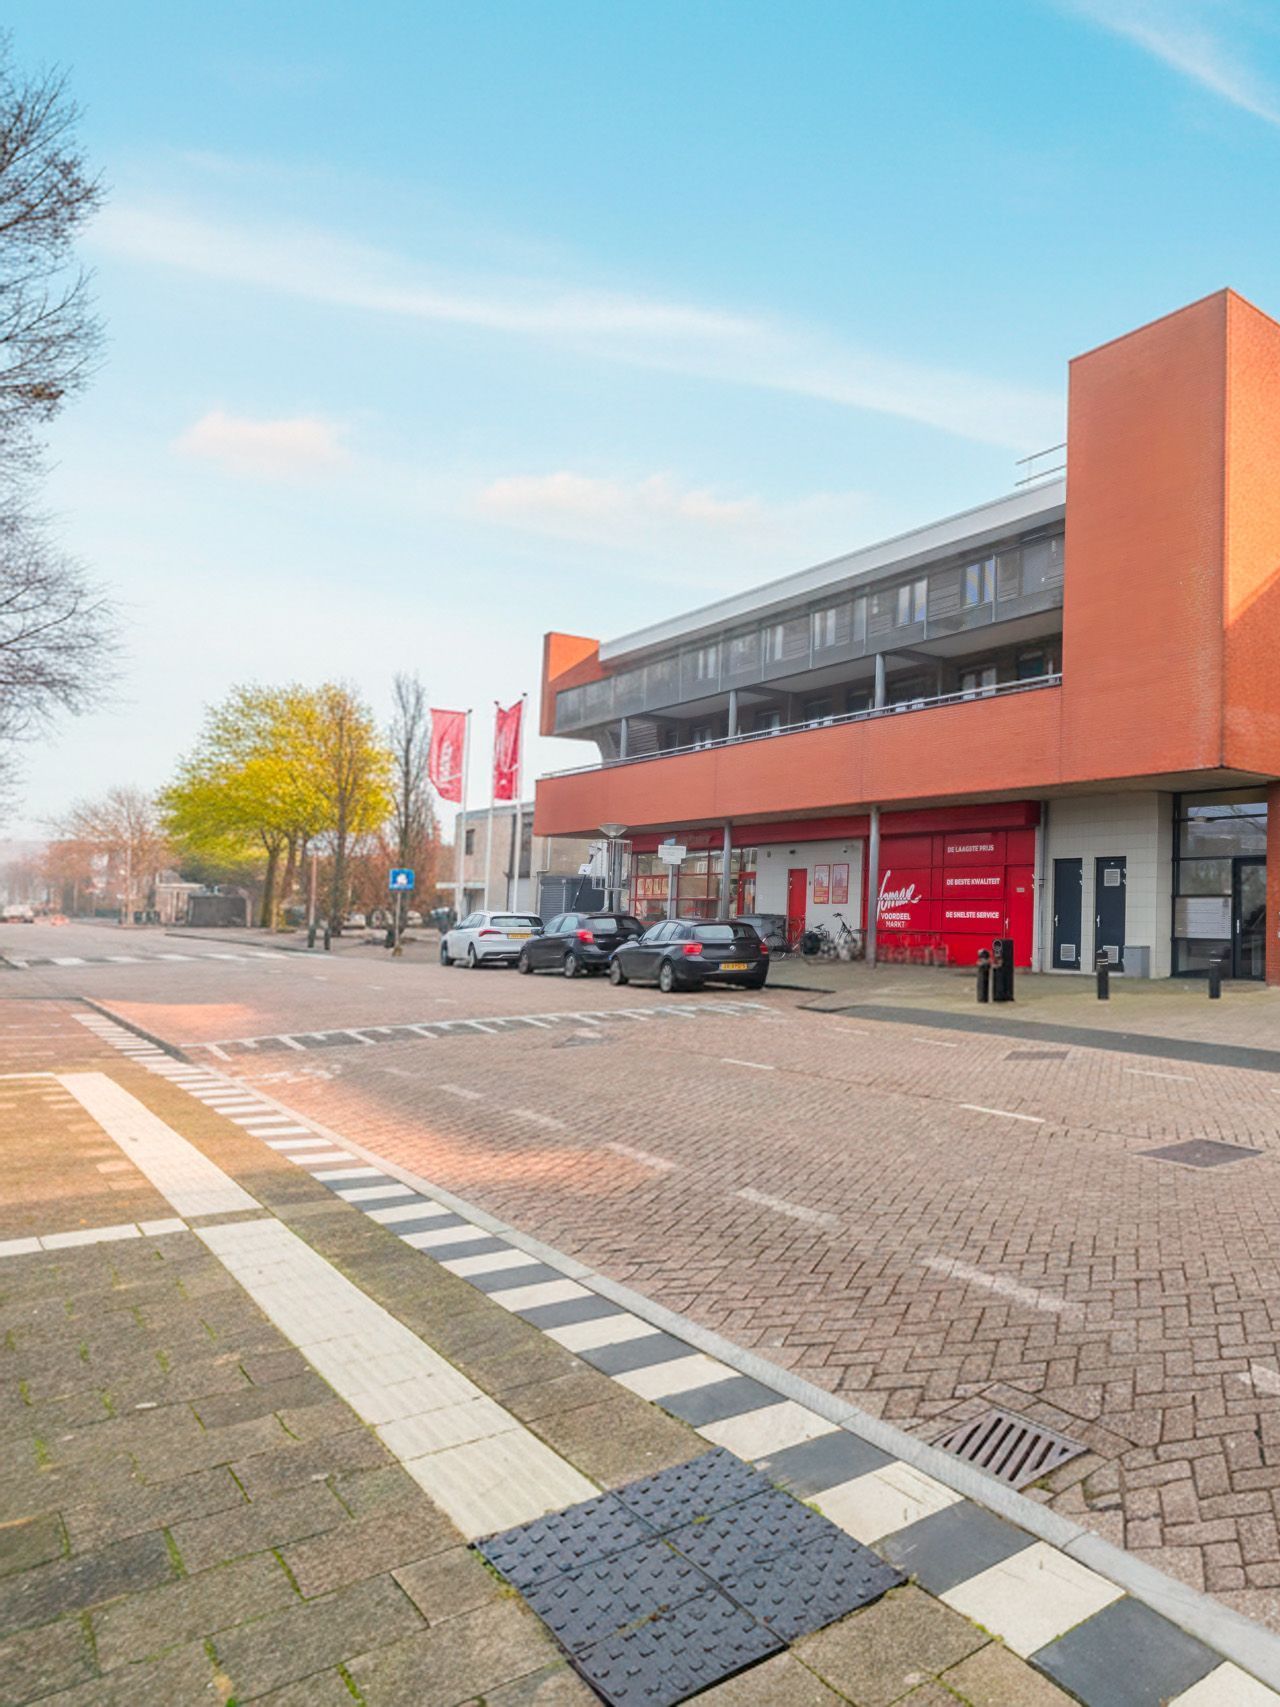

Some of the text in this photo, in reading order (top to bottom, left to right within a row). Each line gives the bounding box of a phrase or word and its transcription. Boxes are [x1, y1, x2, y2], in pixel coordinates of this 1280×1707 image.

[955, 845, 979, 853] LAAGSTE
[979, 844, 994, 852] PRIJS
[886, 920, 905, 928] MARKT
